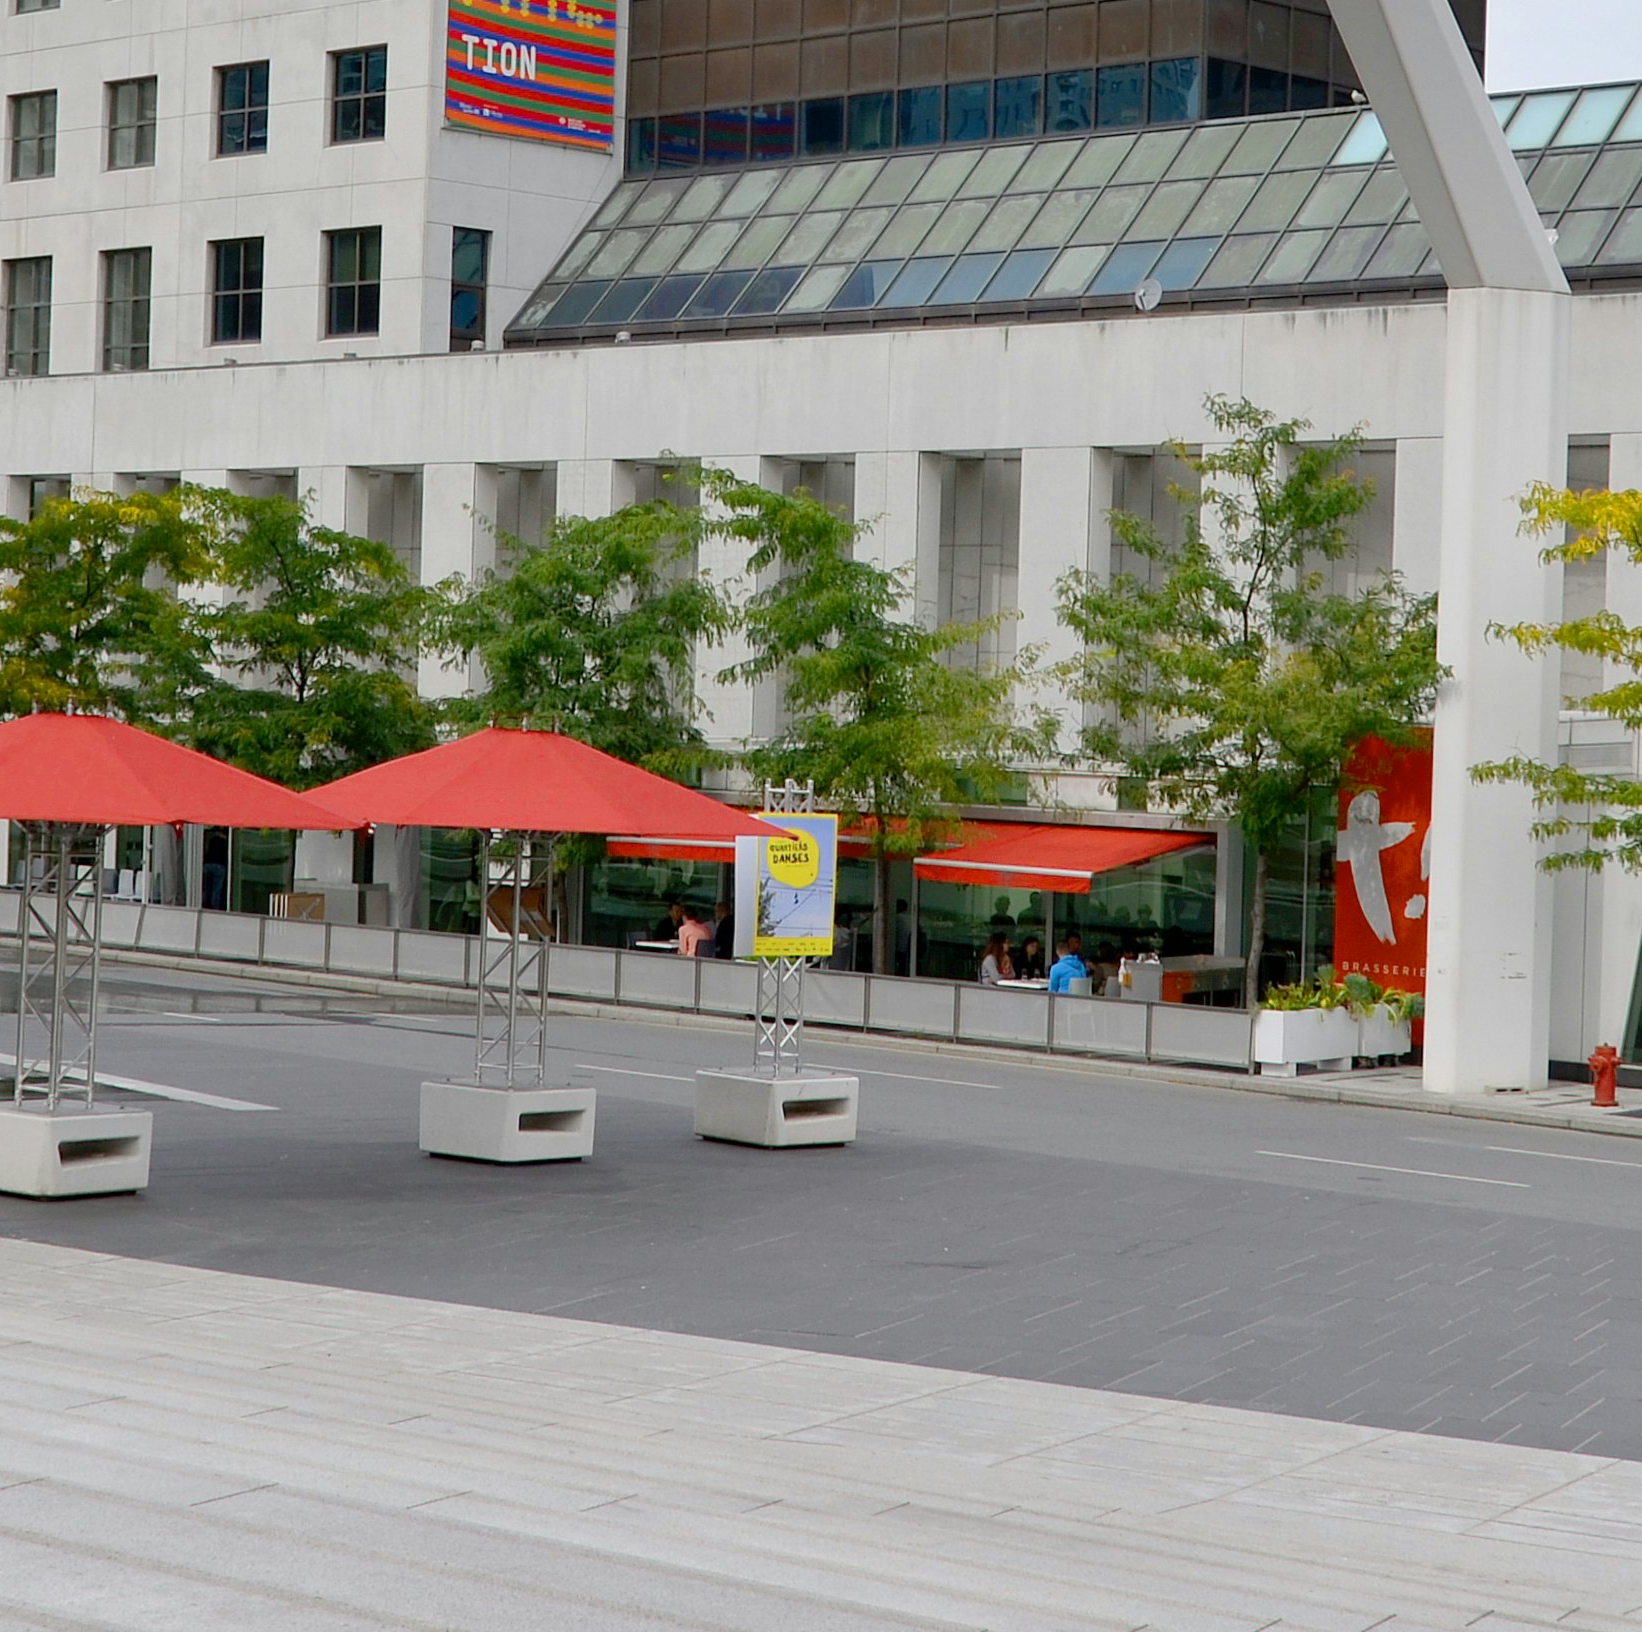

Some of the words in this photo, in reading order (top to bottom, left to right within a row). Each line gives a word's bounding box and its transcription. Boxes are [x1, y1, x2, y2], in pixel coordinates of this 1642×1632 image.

[461, 34, 537, 81] TION
[773, 853, 809, 864] DANSES
[1342, 961, 1426, 977] BRASSERIE
